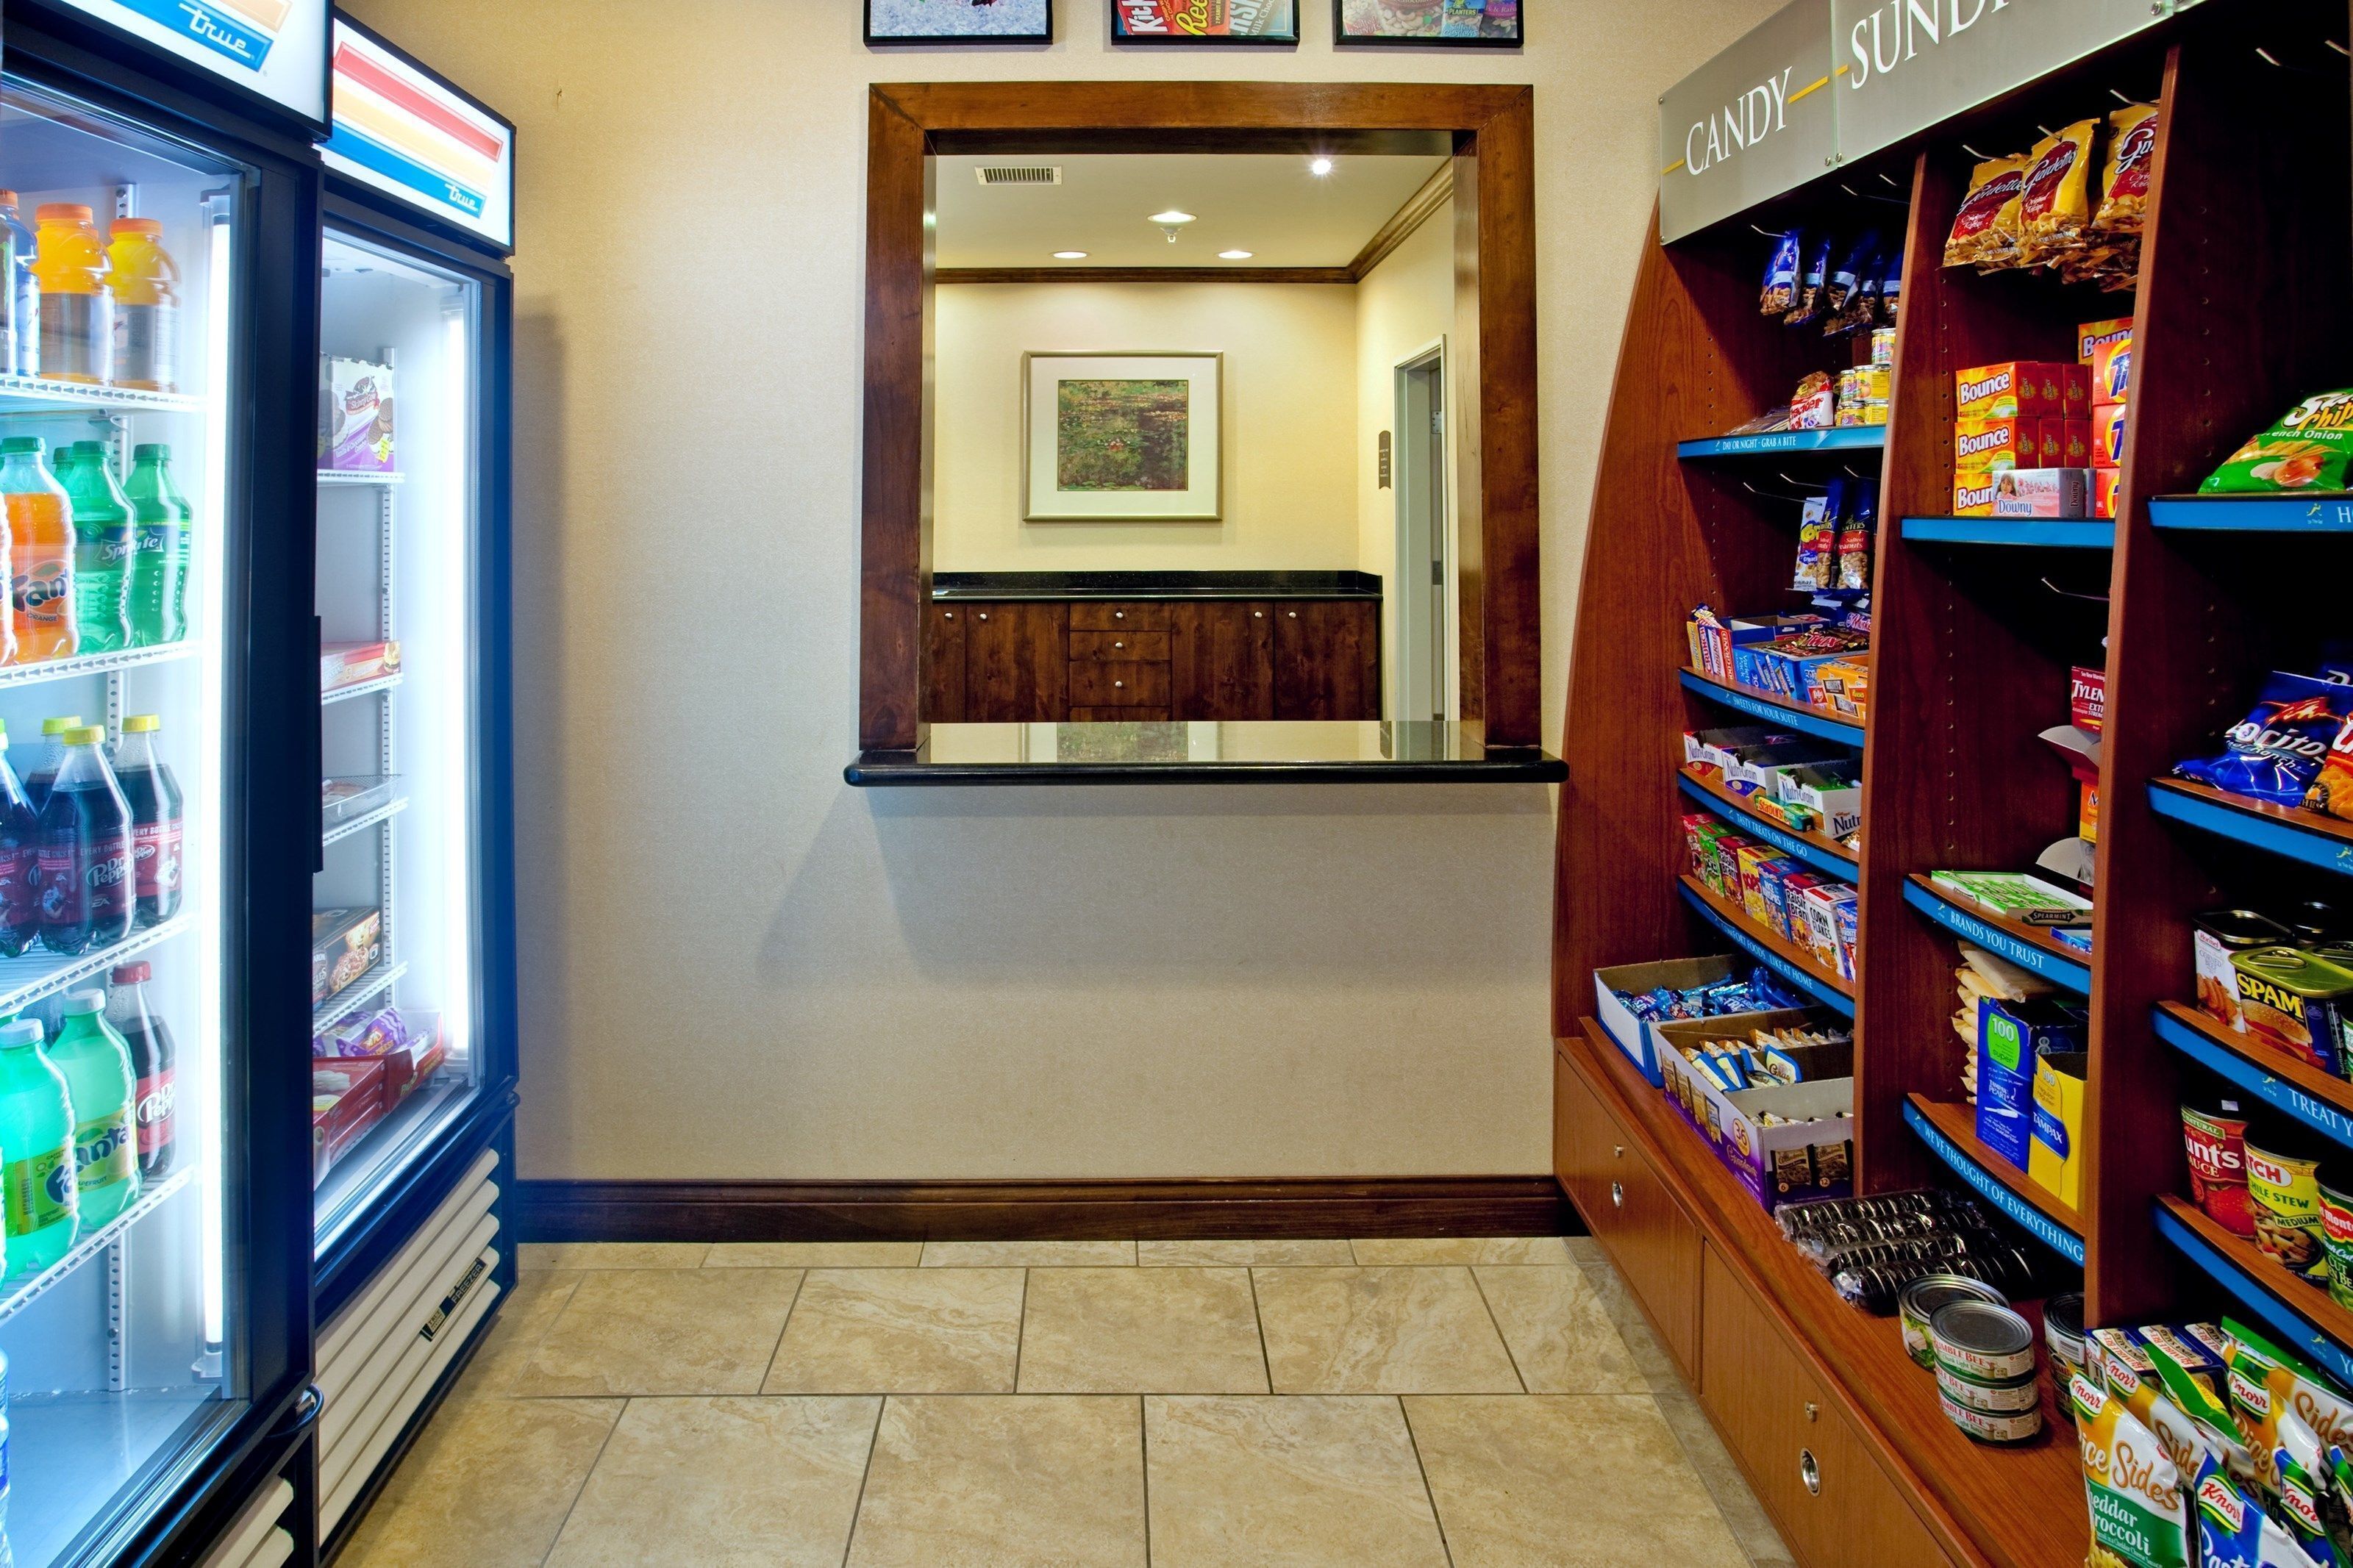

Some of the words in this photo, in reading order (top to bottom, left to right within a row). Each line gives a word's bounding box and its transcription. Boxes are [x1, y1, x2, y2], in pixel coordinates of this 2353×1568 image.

[179, 3, 251, 59] true
[1127, 5, 1168, 32] Kit
[1851, 0, 2010, 89] SUND
[1685, 66, 1793, 176] CANDY
[445, 183, 479, 211] true
[2083, 329, 2132, 358] Boun
[1960, 373, 2010, 404] Bounce
[1740, 439, 1758, 449] NIGHT
[1761, 437, 1777, 448] GRAB
[1782, 436, 1796, 446] BITE
[1958, 426, 2010, 457] Bounce
[2303, 429, 2343, 441] Onion
[1999, 499, 2032, 516] Downy
[26, 612, 58, 623] ORANGE
[1699, 626, 1713, 673] CRUNCH
[1752, 702, 1763, 715] FOR
[1762, 706, 1780, 720] YOUR
[1779, 712, 1799, 726] SUITE
[2251, 745, 2297, 769] Ranch
[1736, 812, 1751, 830] TASTY
[1751, 820, 1771, 840] TREATS
[1771, 831, 1782, 845] ON
[1782, 837, 1796, 853] THE
[1796, 844, 1808, 858] GO
[107, 857, 124, 870] Dr
[91, 896, 110, 908] EA
[1810, 906, 1828, 928] CORN
[2032, 912, 2073, 922] SPEARMINT
[1813, 920, 1832, 940] FLAKES
[1950, 910, 1984, 940] BRANDS
[1985, 928, 2007, 952] YOU
[2009, 941, 2045, 970] TRUST
[1768, 954, 1782, 969] LIKE
[1792, 968, 1814, 989] HOME
[2236, 972, 2304, 1020] SPAM
[1991, 1017, 2015, 1042] 100
[2288, 1088, 2340, 1130] TREAT
[1735, 1121, 1748, 1146] 36
[2032, 1111, 2063, 1145] TAMPAX
[1924, 1123, 1948, 1156] WE'VE
[1946, 1146, 1990, 1192] THOUGHT
[1991, 1185, 2005, 1204] OF
[2007, 1198, 2084, 1263] EVERYTHING
[2272, 1192, 2310, 1209] STEW
[2277, 1217, 2319, 1228] MEDIUM
[2327, 1254, 2348, 1276] CUT
[451, 1264, 484, 1304] FREEZER
[2160, 1328, 2178, 1347] SALAD
[1965, 1352, 1986, 1367] BEE
[2160, 1342, 2191, 1367] BUMBLE
[1948, 1373, 1966, 1391] BEE
[1965, 1412, 1986, 1429] BEE
[2112, 1439, 2180, 1511] Sides
[2201, 1482, 2241, 1522] Knorr
